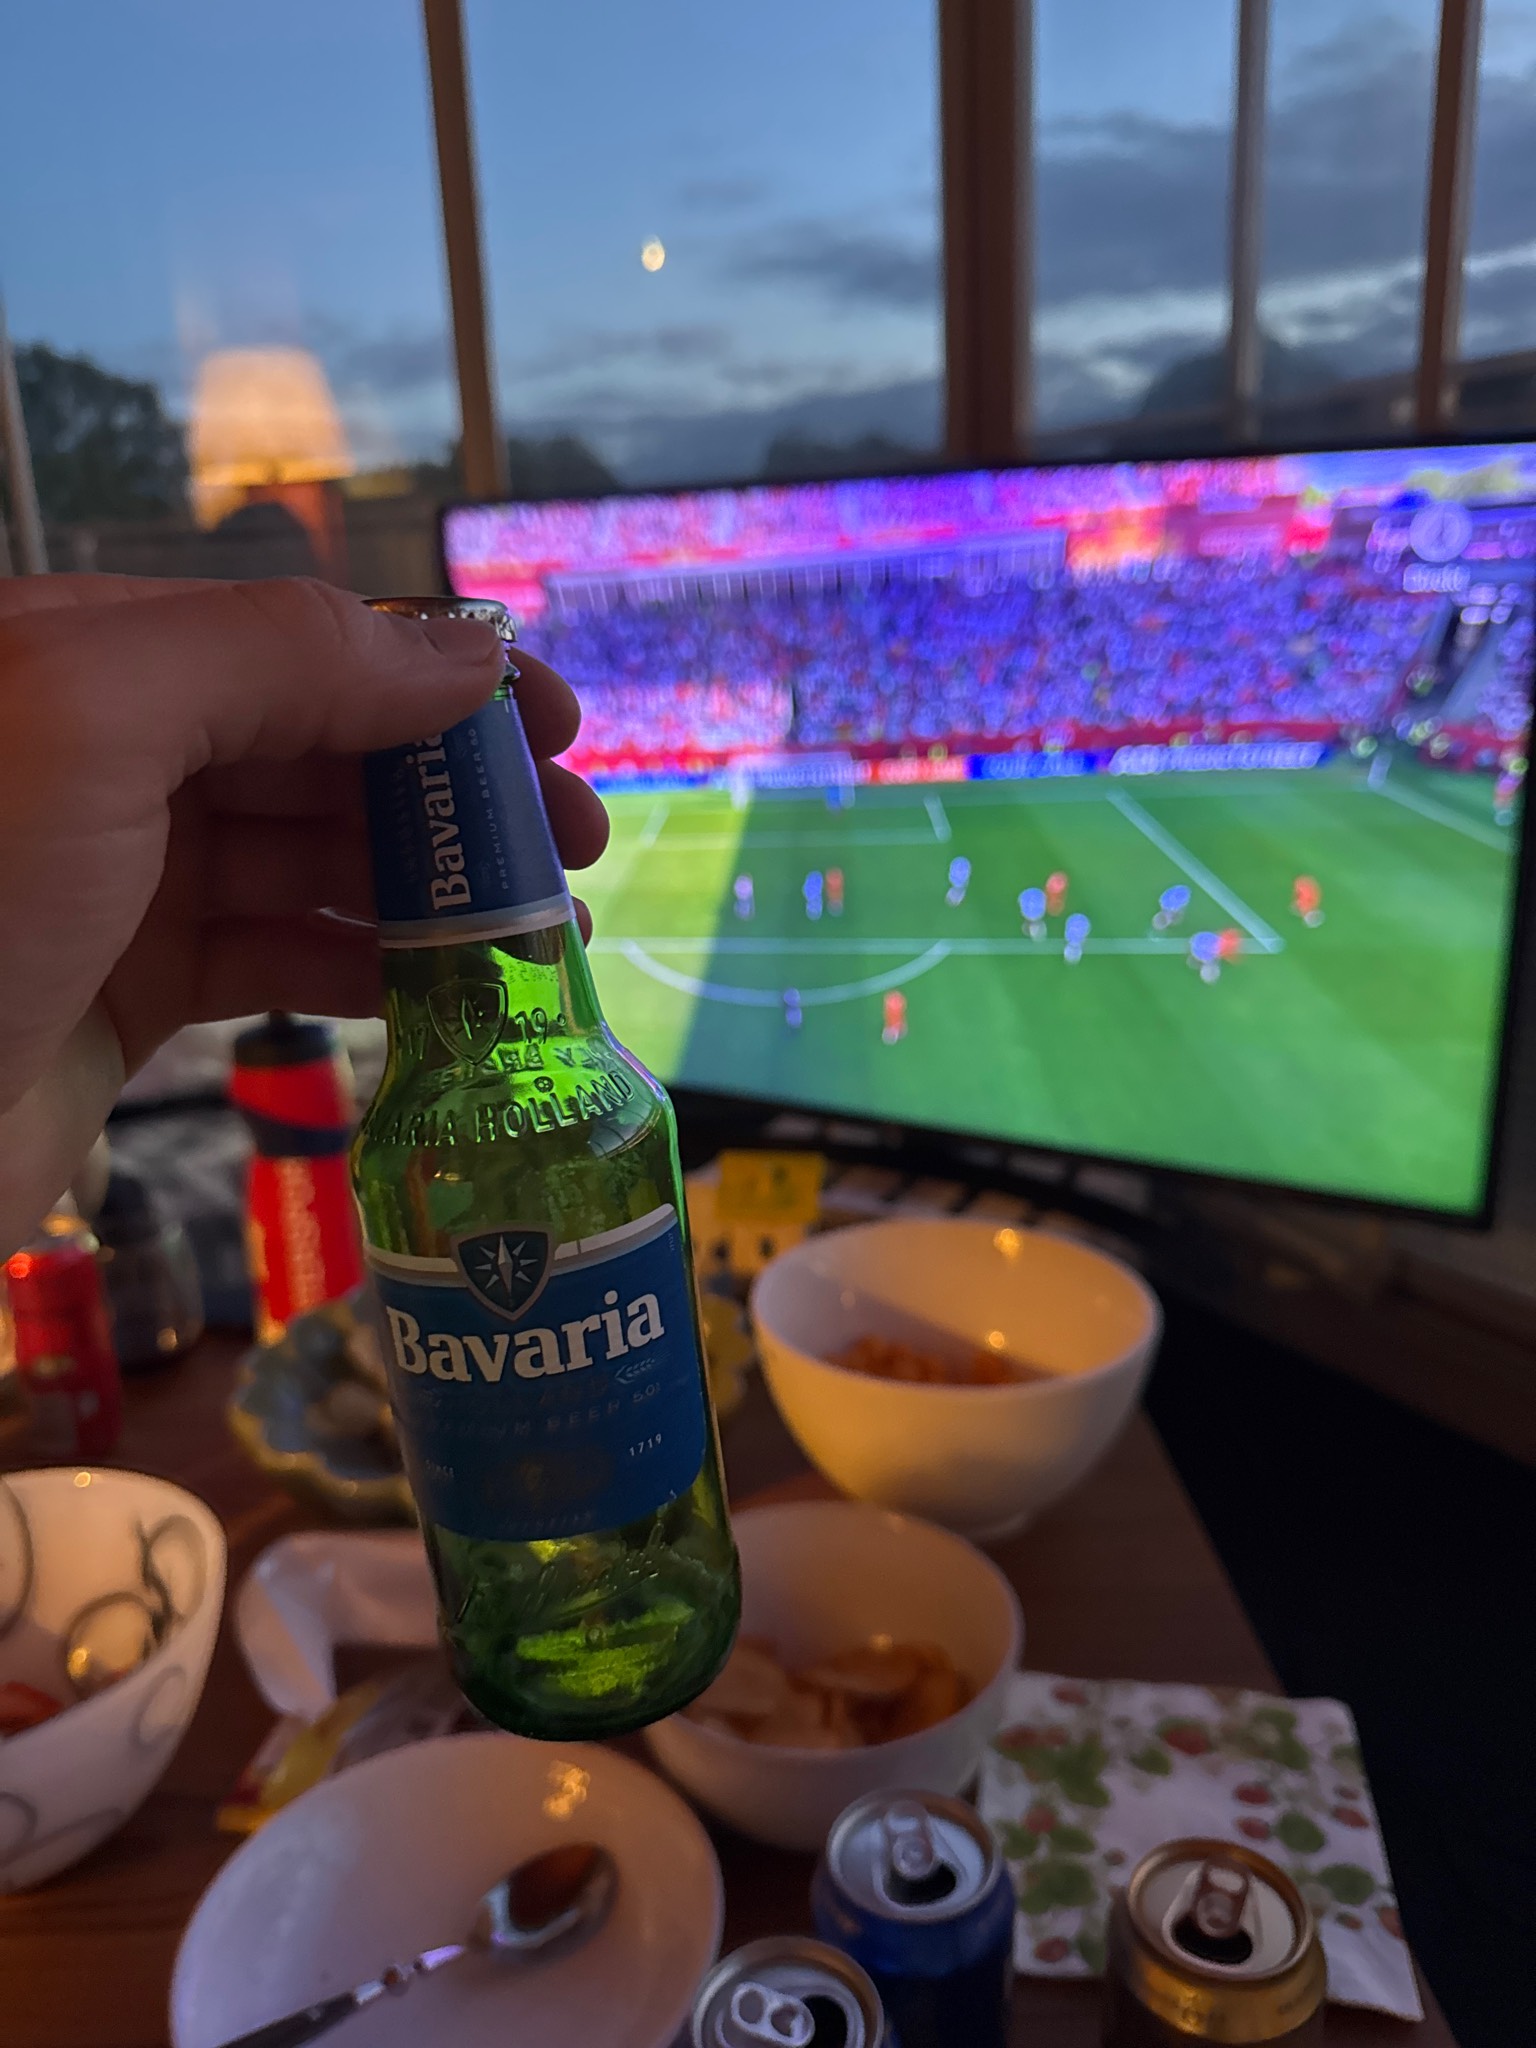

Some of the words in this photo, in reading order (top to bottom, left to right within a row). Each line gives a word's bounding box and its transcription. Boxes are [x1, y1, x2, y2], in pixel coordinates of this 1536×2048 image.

[473, 751, 491, 799] BEER
[486, 807, 509, 890] PREMIUM
[475, 1069, 637, 1144] HOLLAND
[385, 1289, 665, 1383] Bavaria
[629, 1432, 663, 1457] 1719
